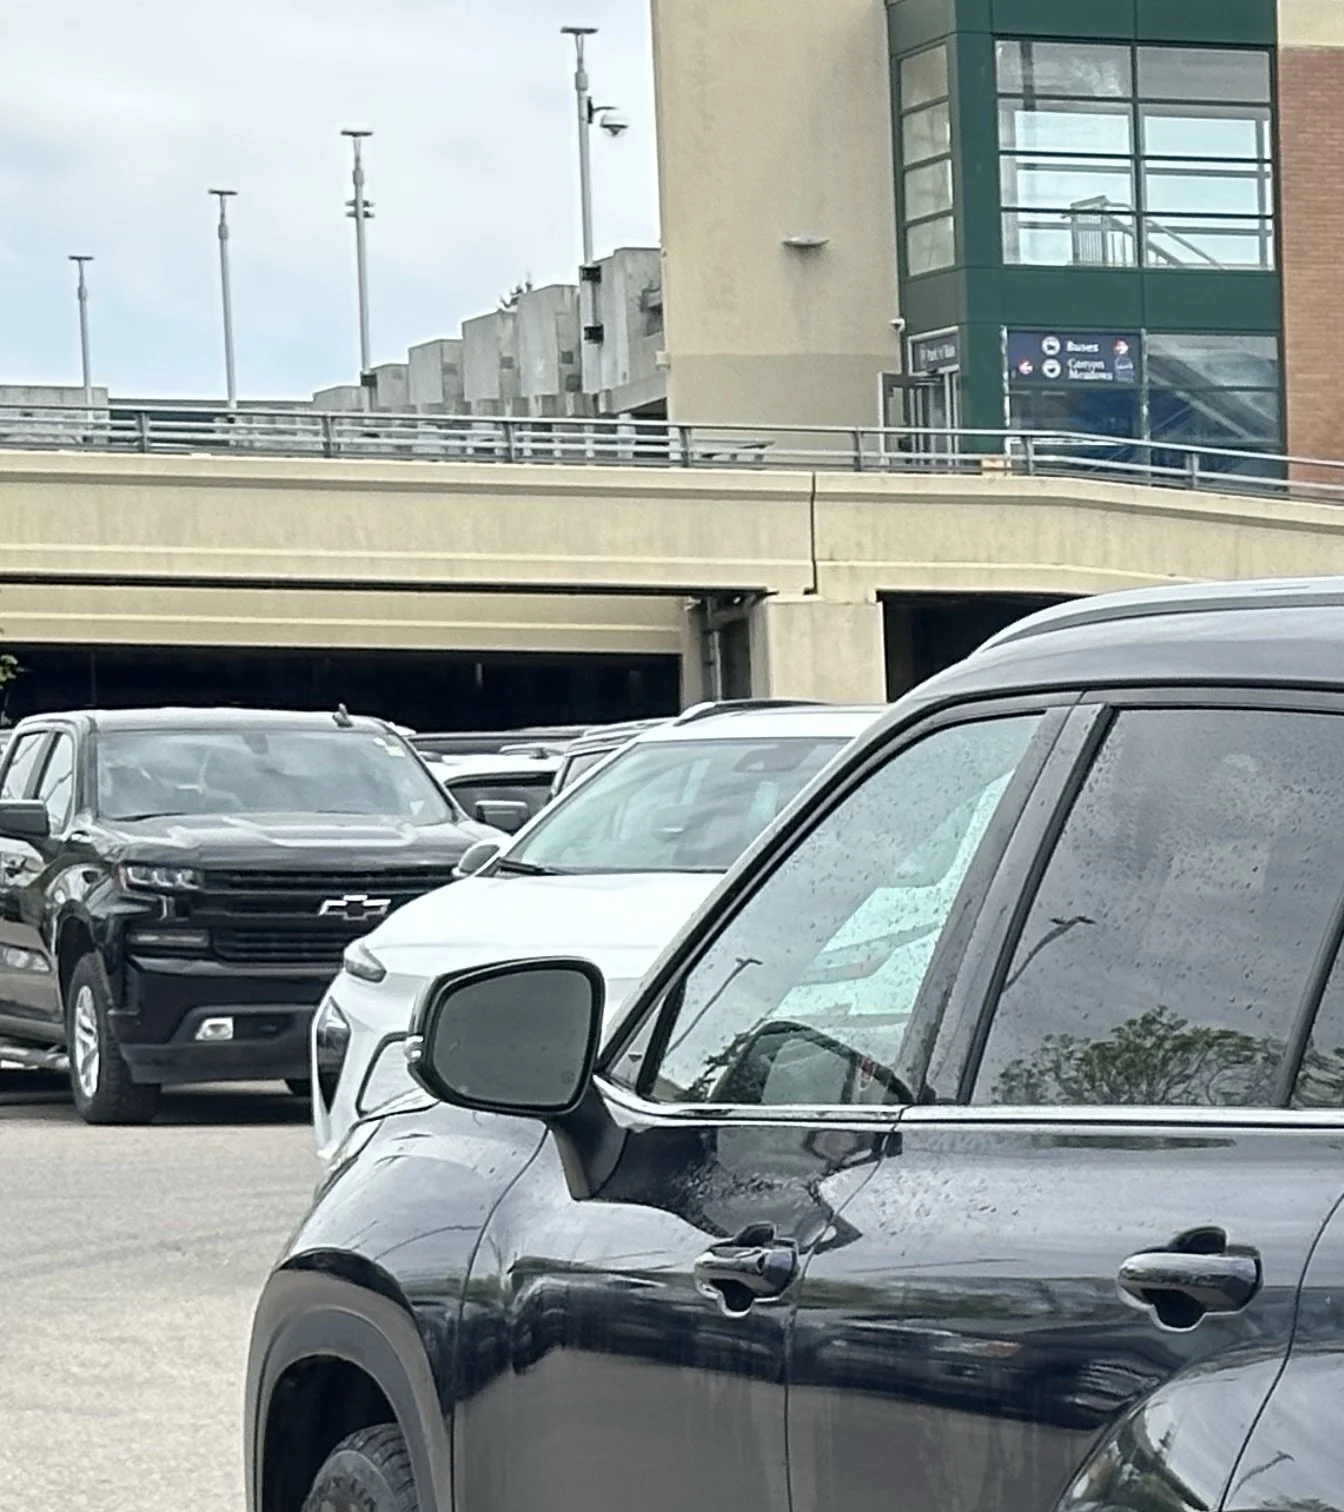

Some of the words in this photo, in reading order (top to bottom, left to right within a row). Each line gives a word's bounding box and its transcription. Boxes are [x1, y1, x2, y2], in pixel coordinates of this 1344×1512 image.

[1066, 340, 1099, 352] Buses
[1067, 358, 1105, 371] Canyon
[1068, 368, 1113, 381] Meadows
